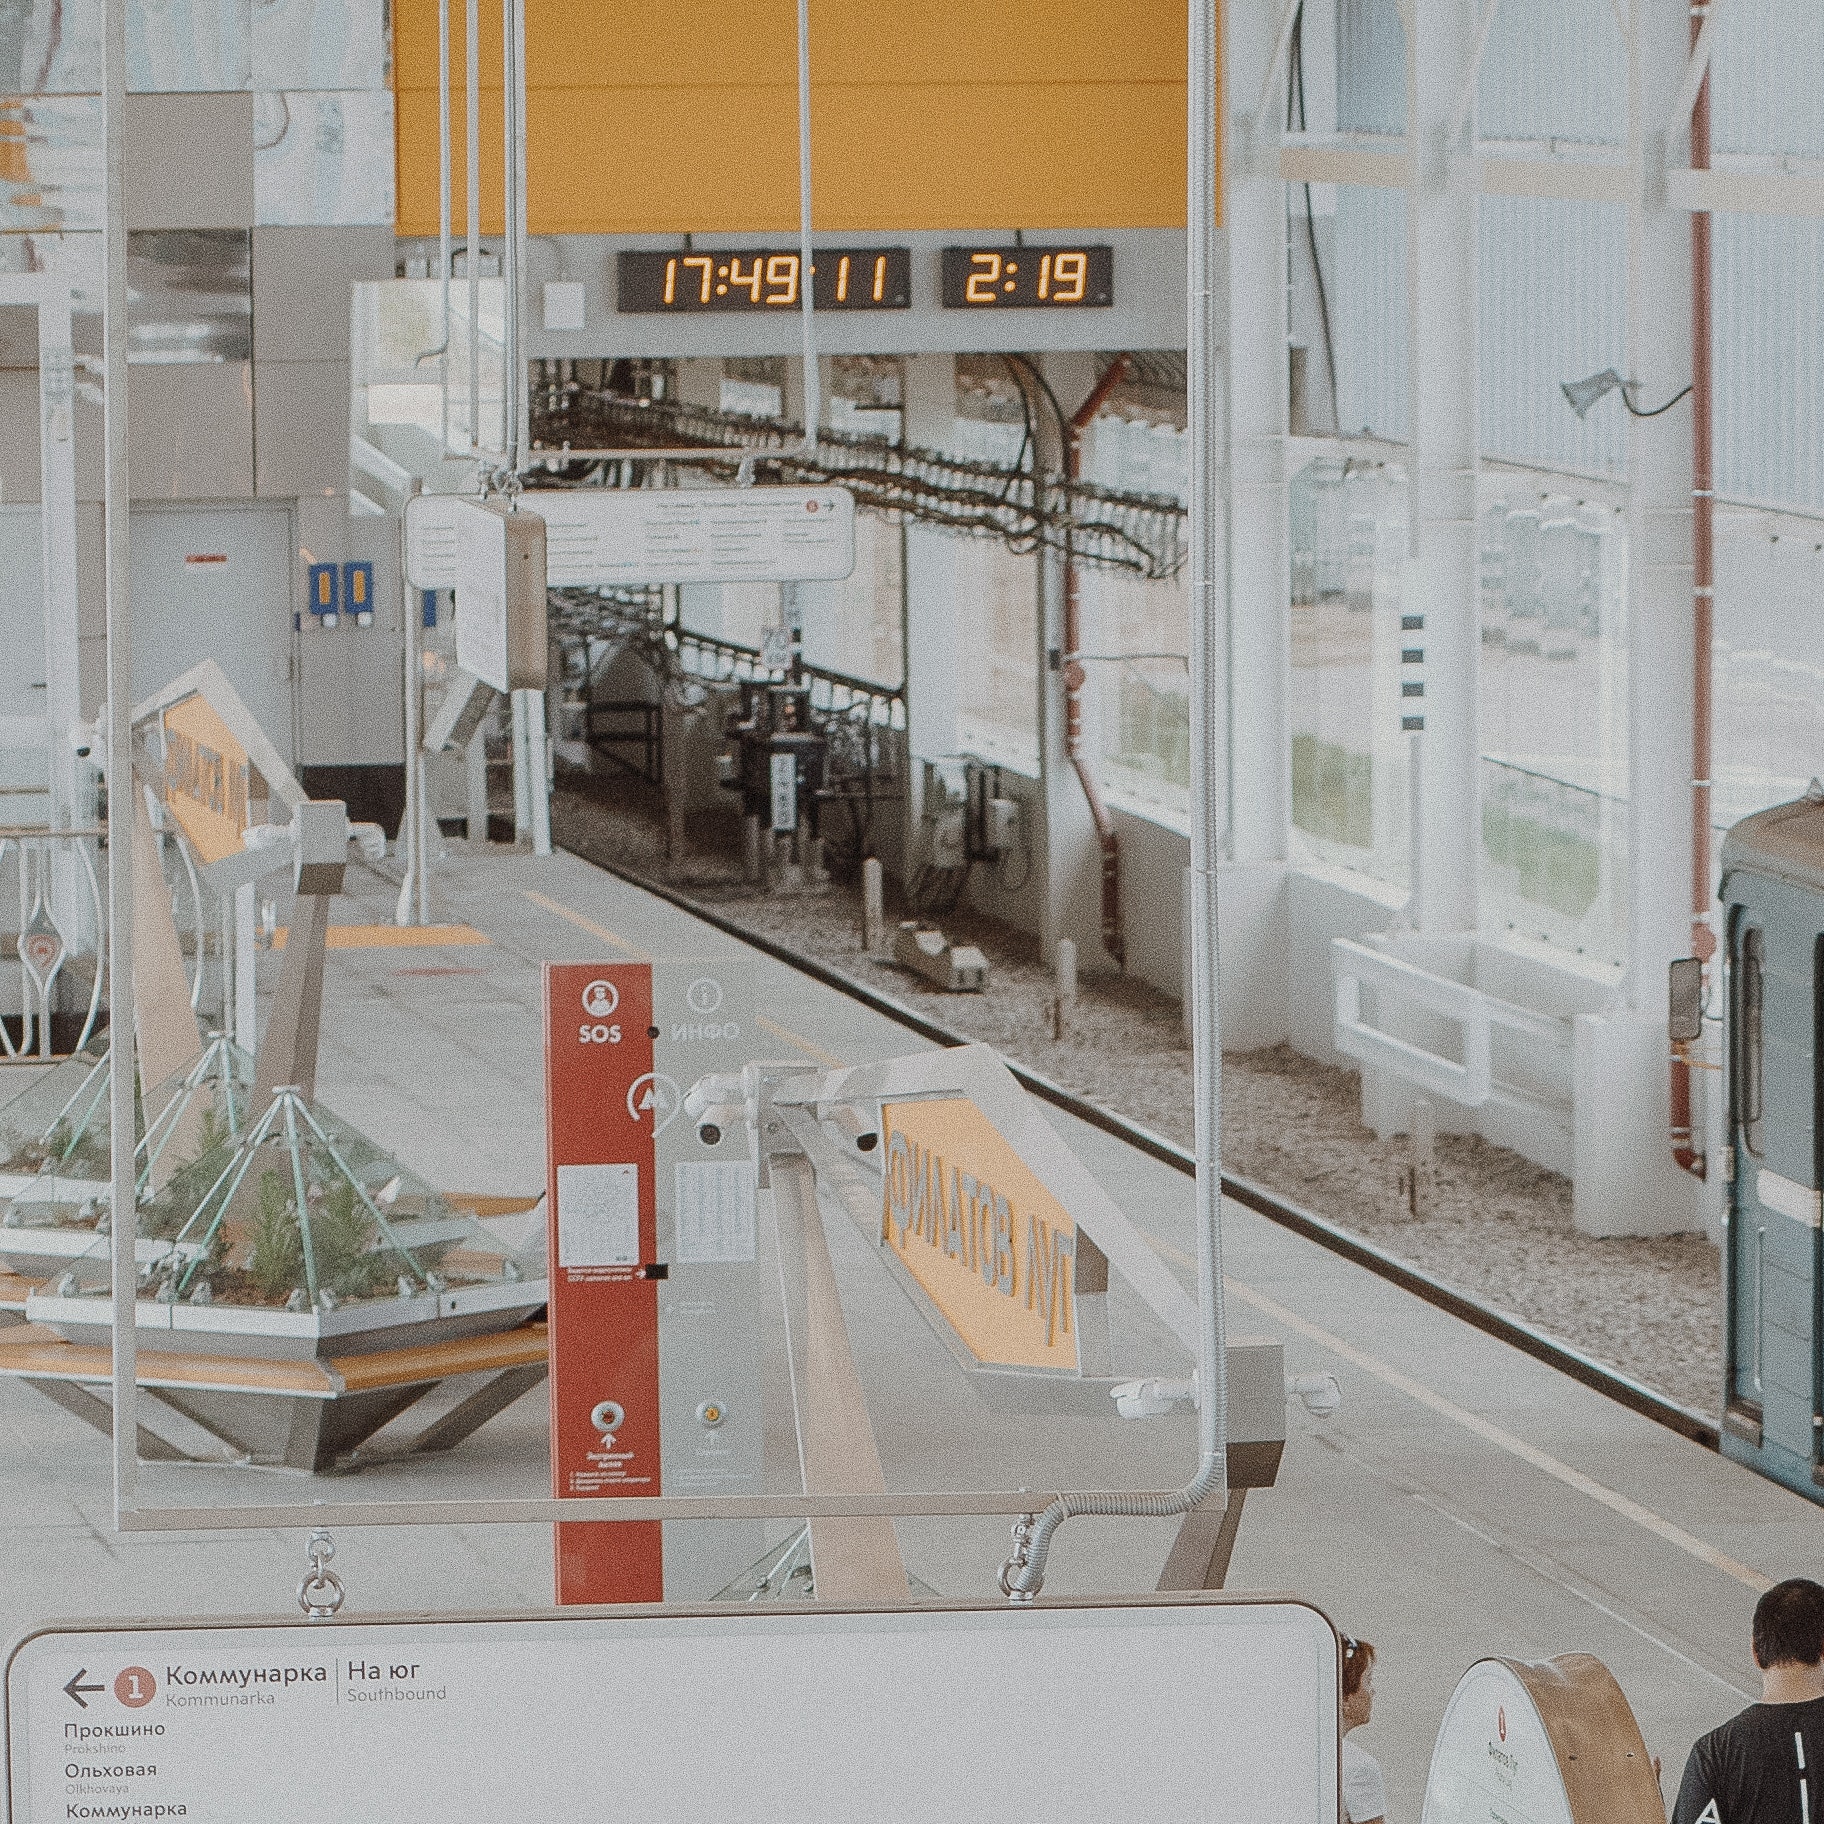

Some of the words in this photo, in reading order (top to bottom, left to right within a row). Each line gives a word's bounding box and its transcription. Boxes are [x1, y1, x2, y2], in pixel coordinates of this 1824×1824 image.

[966, 253, 1087, 301] 2:19
[579, 1025, 622, 1043] SOS
[166, 1665, 327, 1689] Коммунарка
[347, 1660, 381, 1681] На
[389, 1664, 420, 1680] юг
[167, 1692, 275, 1707] Kommunarka
[348, 1685, 446, 1702] Southbound
[63, 1722, 166, 1742] Прокшино
[64, 1762, 158, 1779] Ольховая
[65, 1803, 188, 1821] Коммунарка
